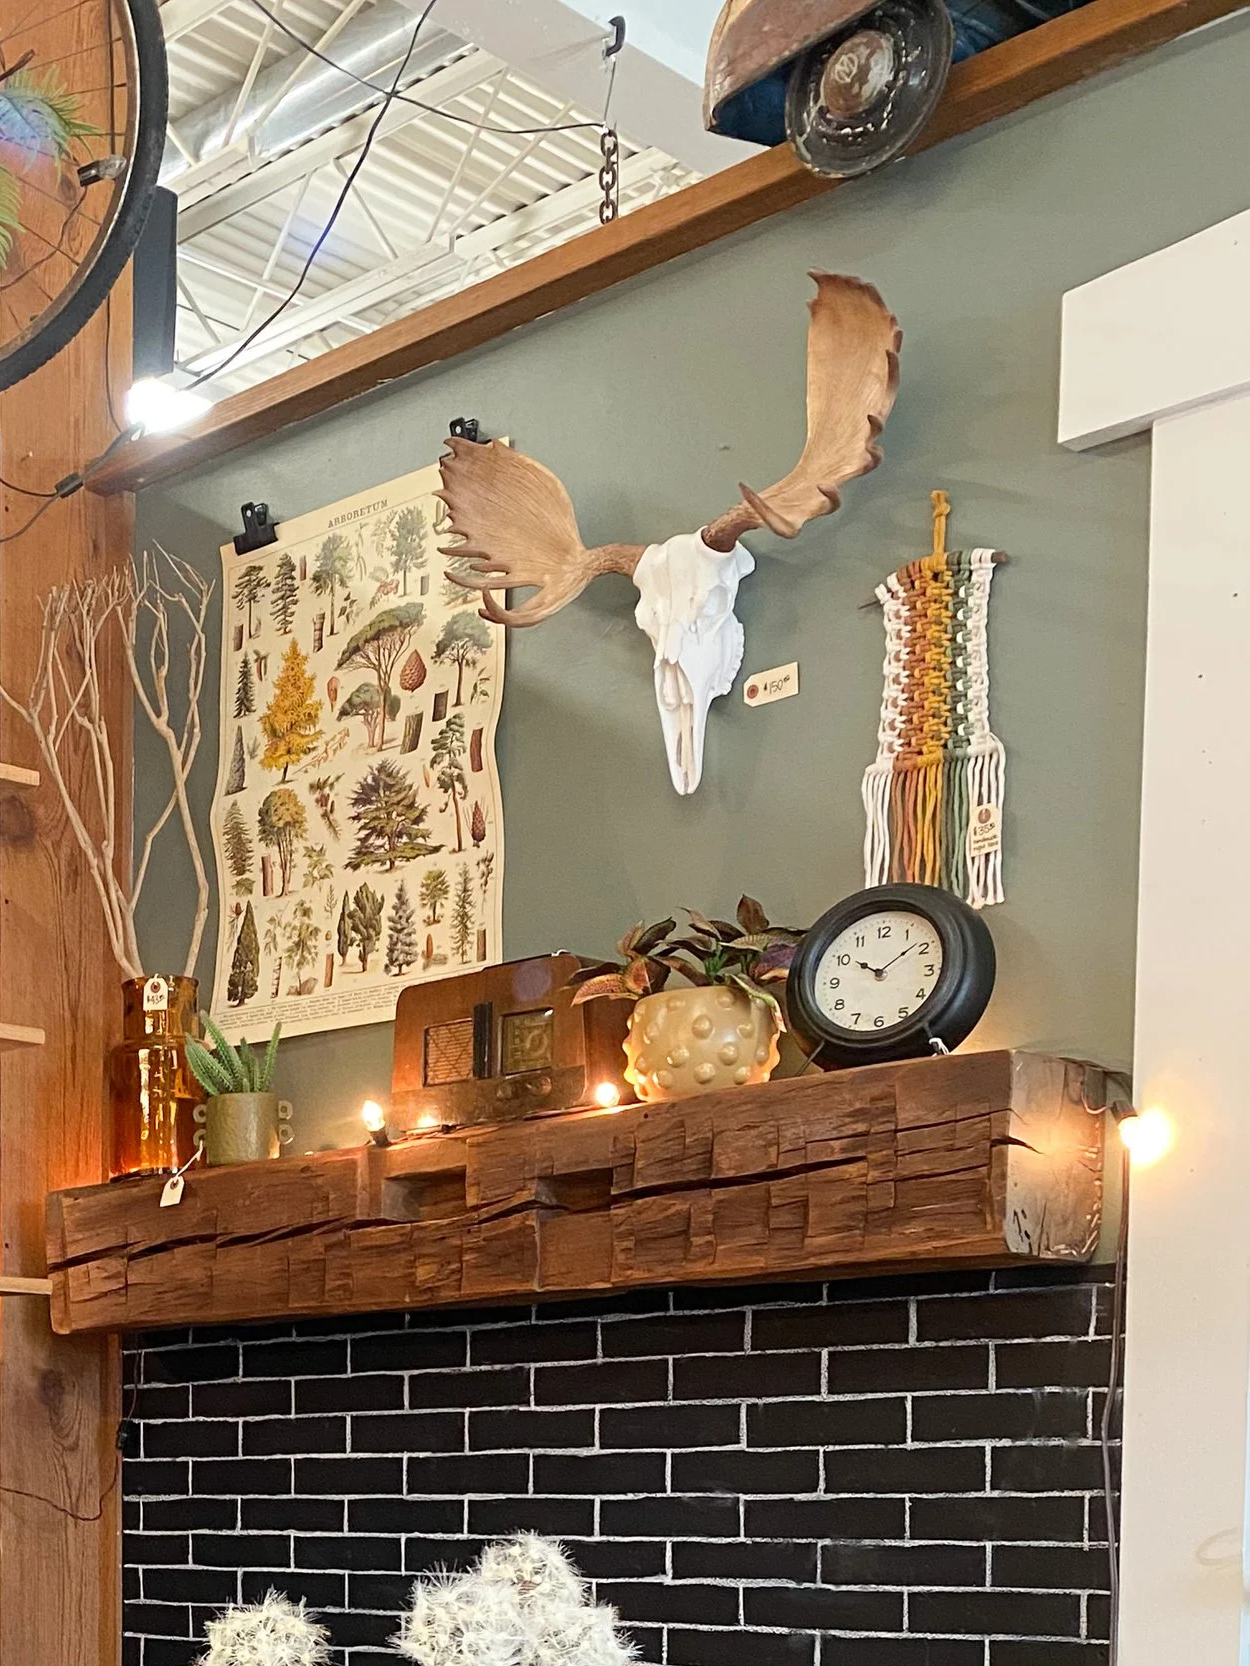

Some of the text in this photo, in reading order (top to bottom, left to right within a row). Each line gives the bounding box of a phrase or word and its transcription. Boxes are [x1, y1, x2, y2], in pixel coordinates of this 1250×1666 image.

[328, 499, 388, 529] ARBORETUM
[877, 926, 891, 939] 12
[905, 929, 910, 940] 1
[855, 936, 865, 948] 11
[918, 942, 929, 955] 2
[837, 954, 851, 966] 10
[924, 964, 935, 977] 3
[830, 977, 840, 989] 9
[915, 988, 926, 1000] 4
[834, 999, 845, 1011] 8
[851, 1013, 861, 1025] 7
[898, 1007, 909, 1019] 5
[874, 1016, 884, 1027] 6
